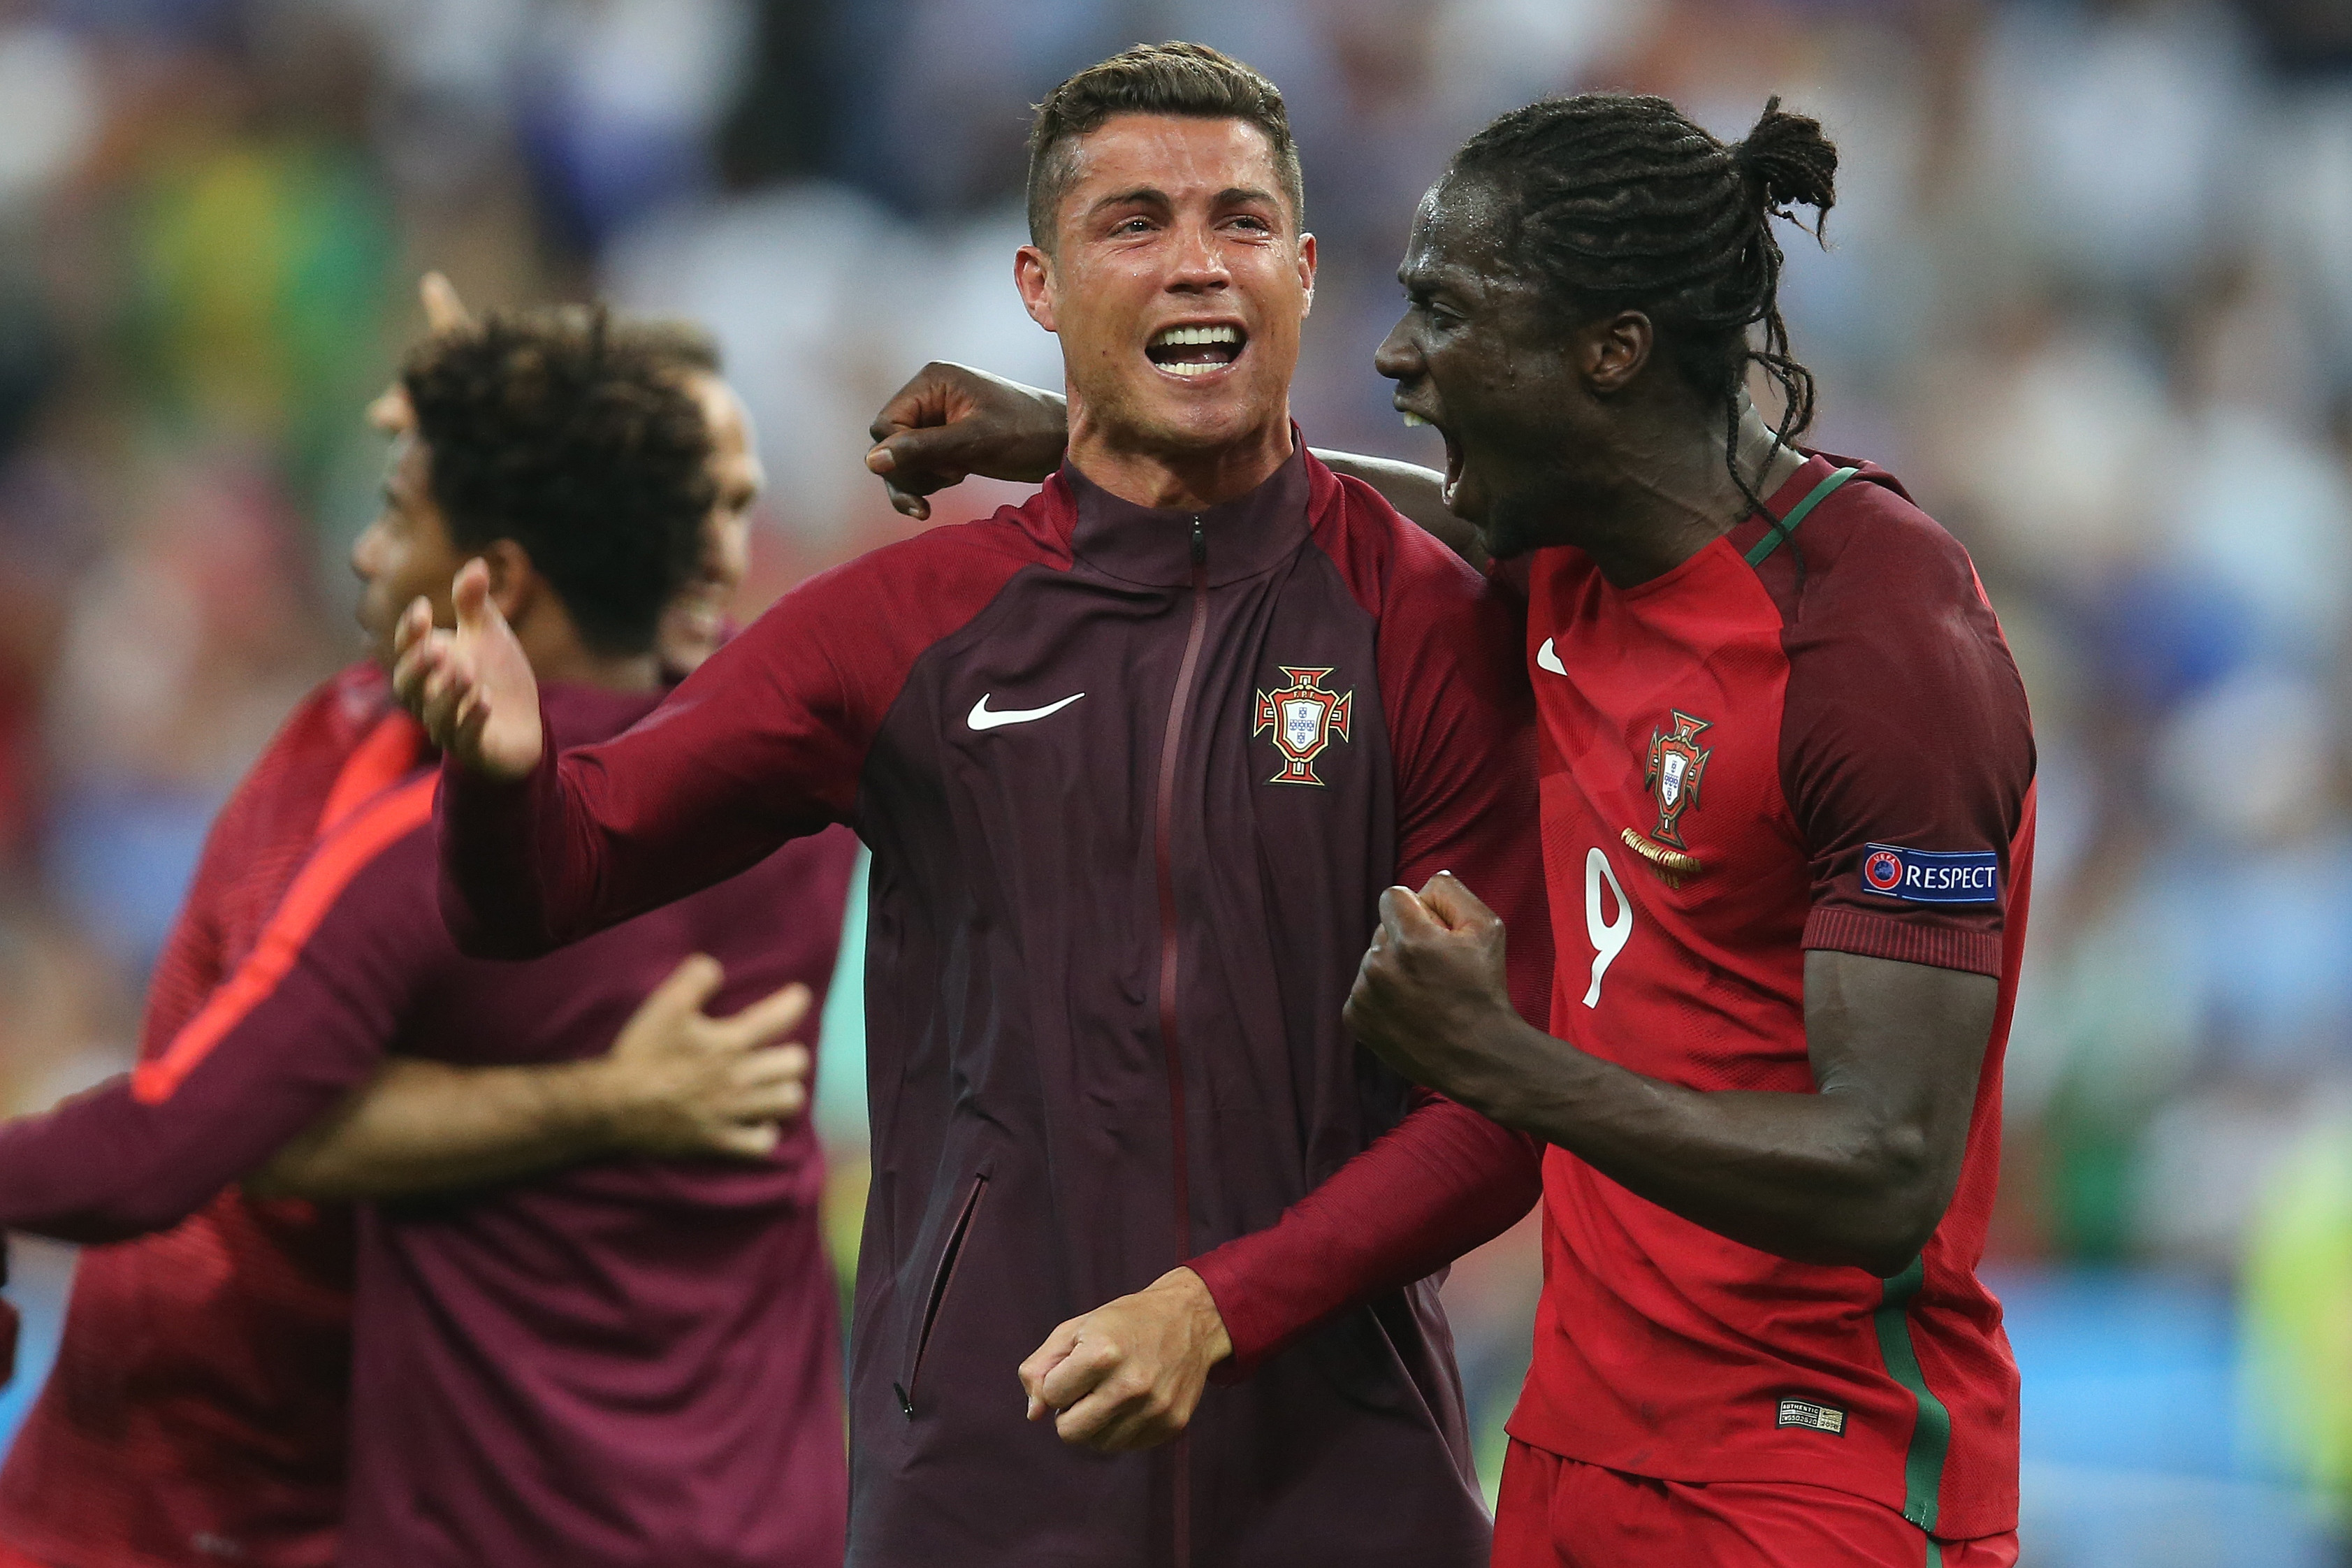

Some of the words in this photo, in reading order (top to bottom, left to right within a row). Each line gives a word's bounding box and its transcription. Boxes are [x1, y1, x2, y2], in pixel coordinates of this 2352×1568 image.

[1873, 853, 1896, 864] UEFA
[1905, 865, 1996, 889] RESPECT
[1582, 847, 1633, 1009] 9
[1783, 1404, 1819, 1414] AUTHENTIC
